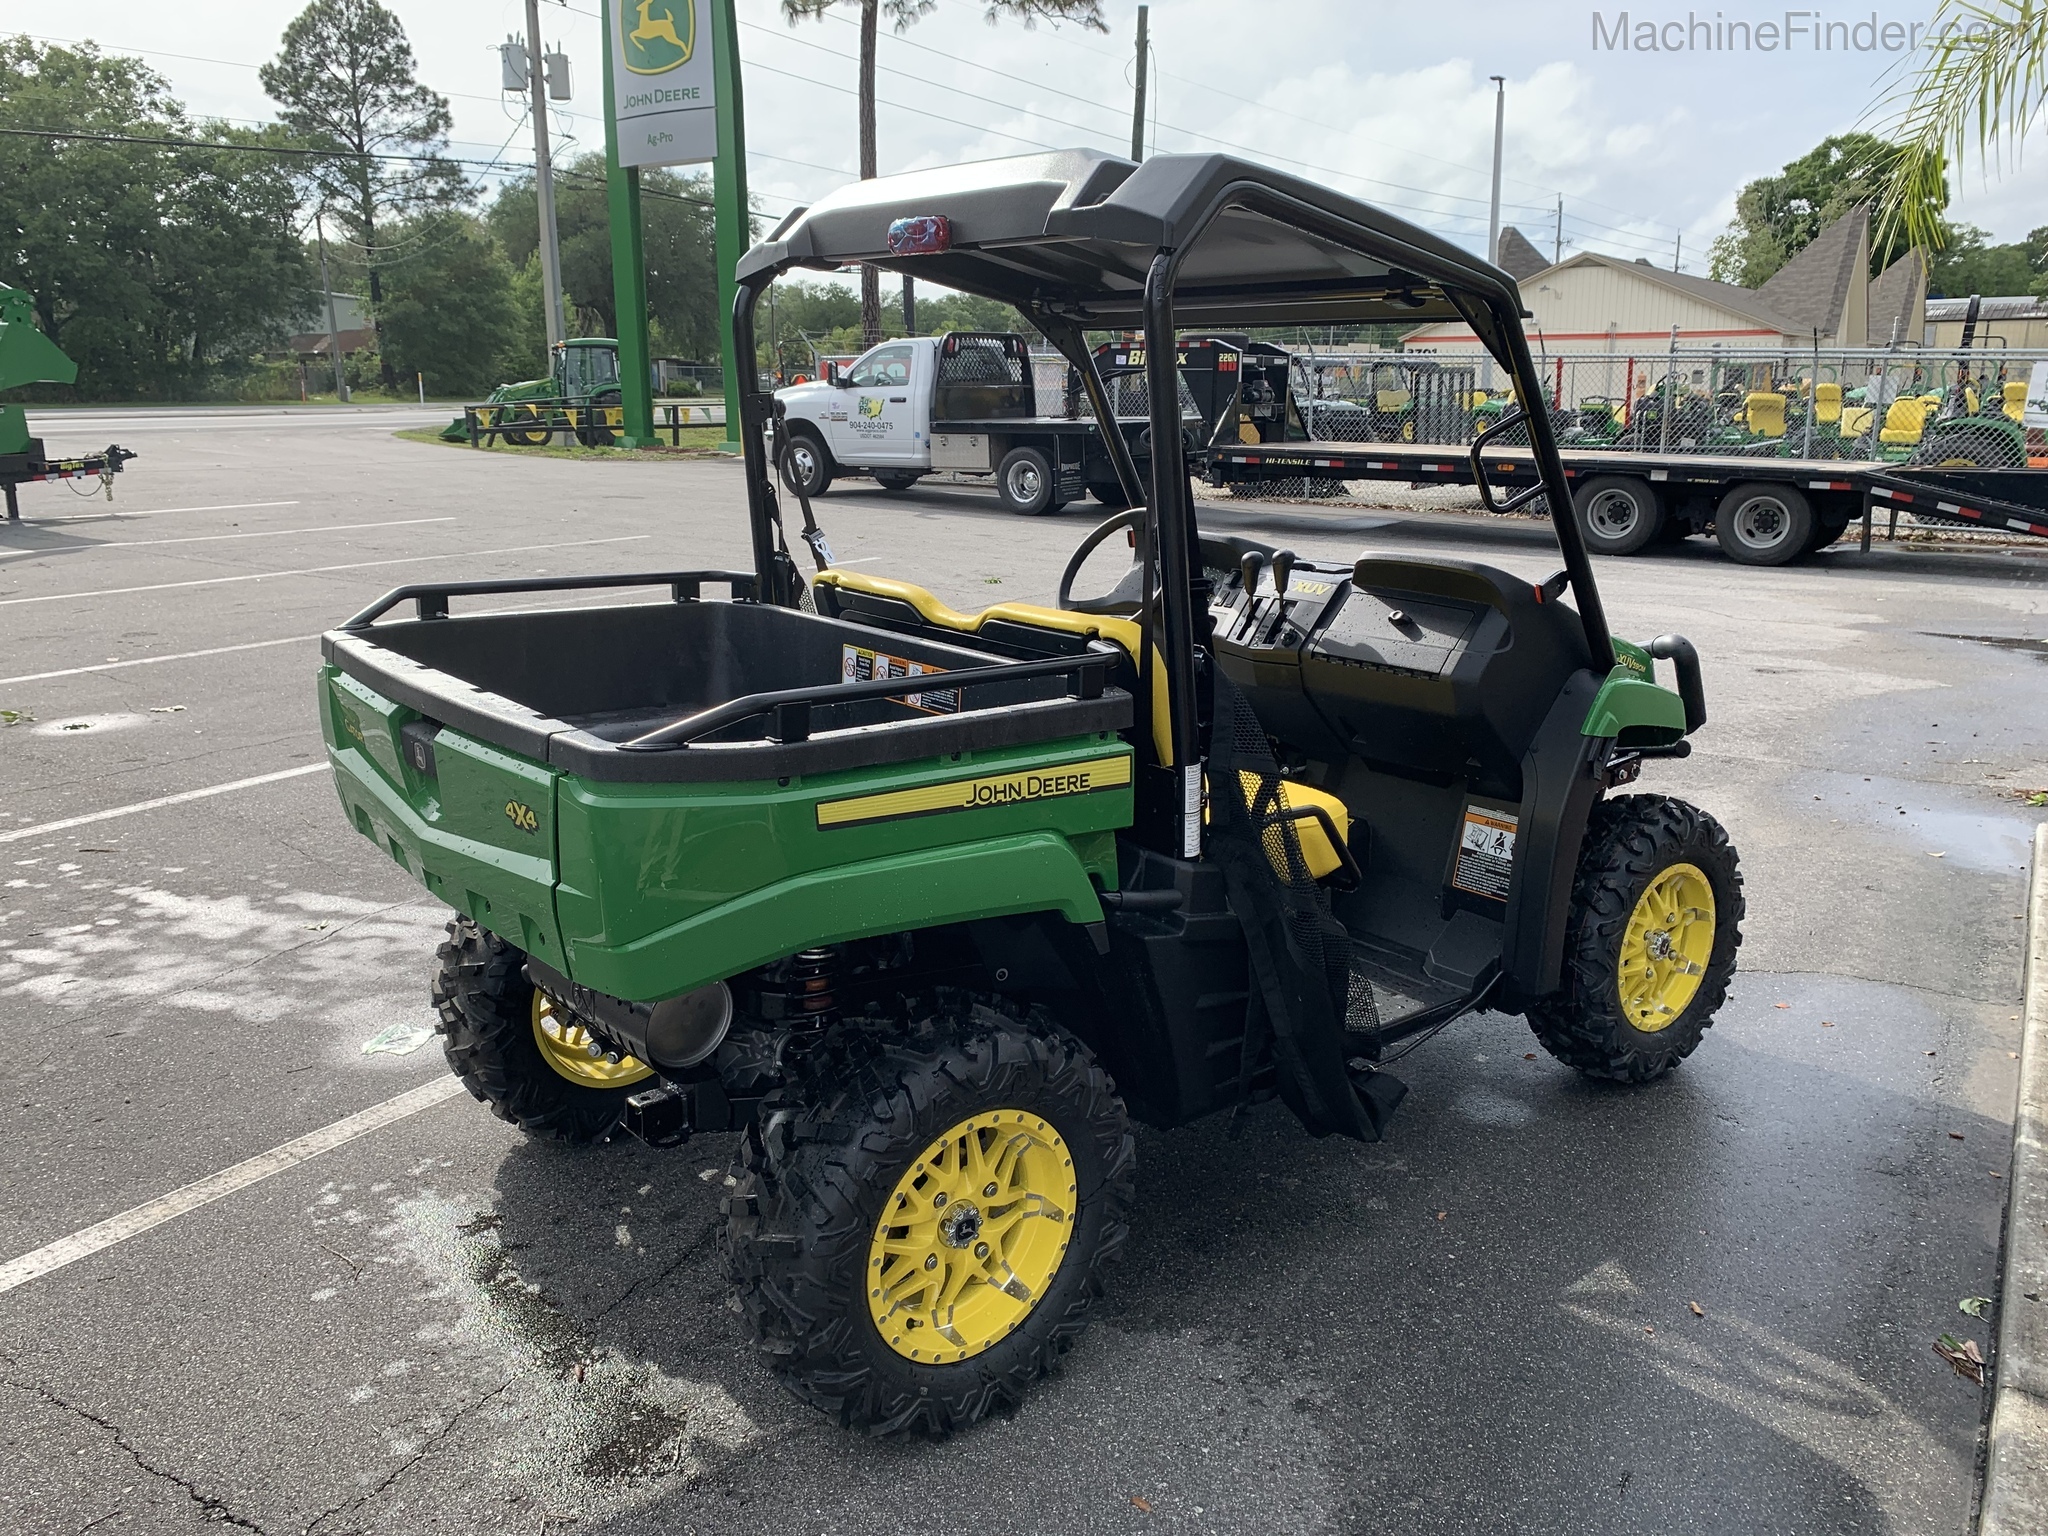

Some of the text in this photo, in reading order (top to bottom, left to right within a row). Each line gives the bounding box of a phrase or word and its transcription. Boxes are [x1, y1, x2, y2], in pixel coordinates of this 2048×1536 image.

[623, 87, 700, 109] JOHN DEERE
[647, 131, 674, 147] Ag-Pro
[1218, 361, 1237, 372] HD
[849, 421, 893, 430] 904-240-0475
[1265, 457, 1311, 466] HI-TENSILE
[1292, 581, 1332, 595] XUV
[965, 772, 1091, 805] JOHN DEERE
[1490, 820, 1512, 830] WARNING
